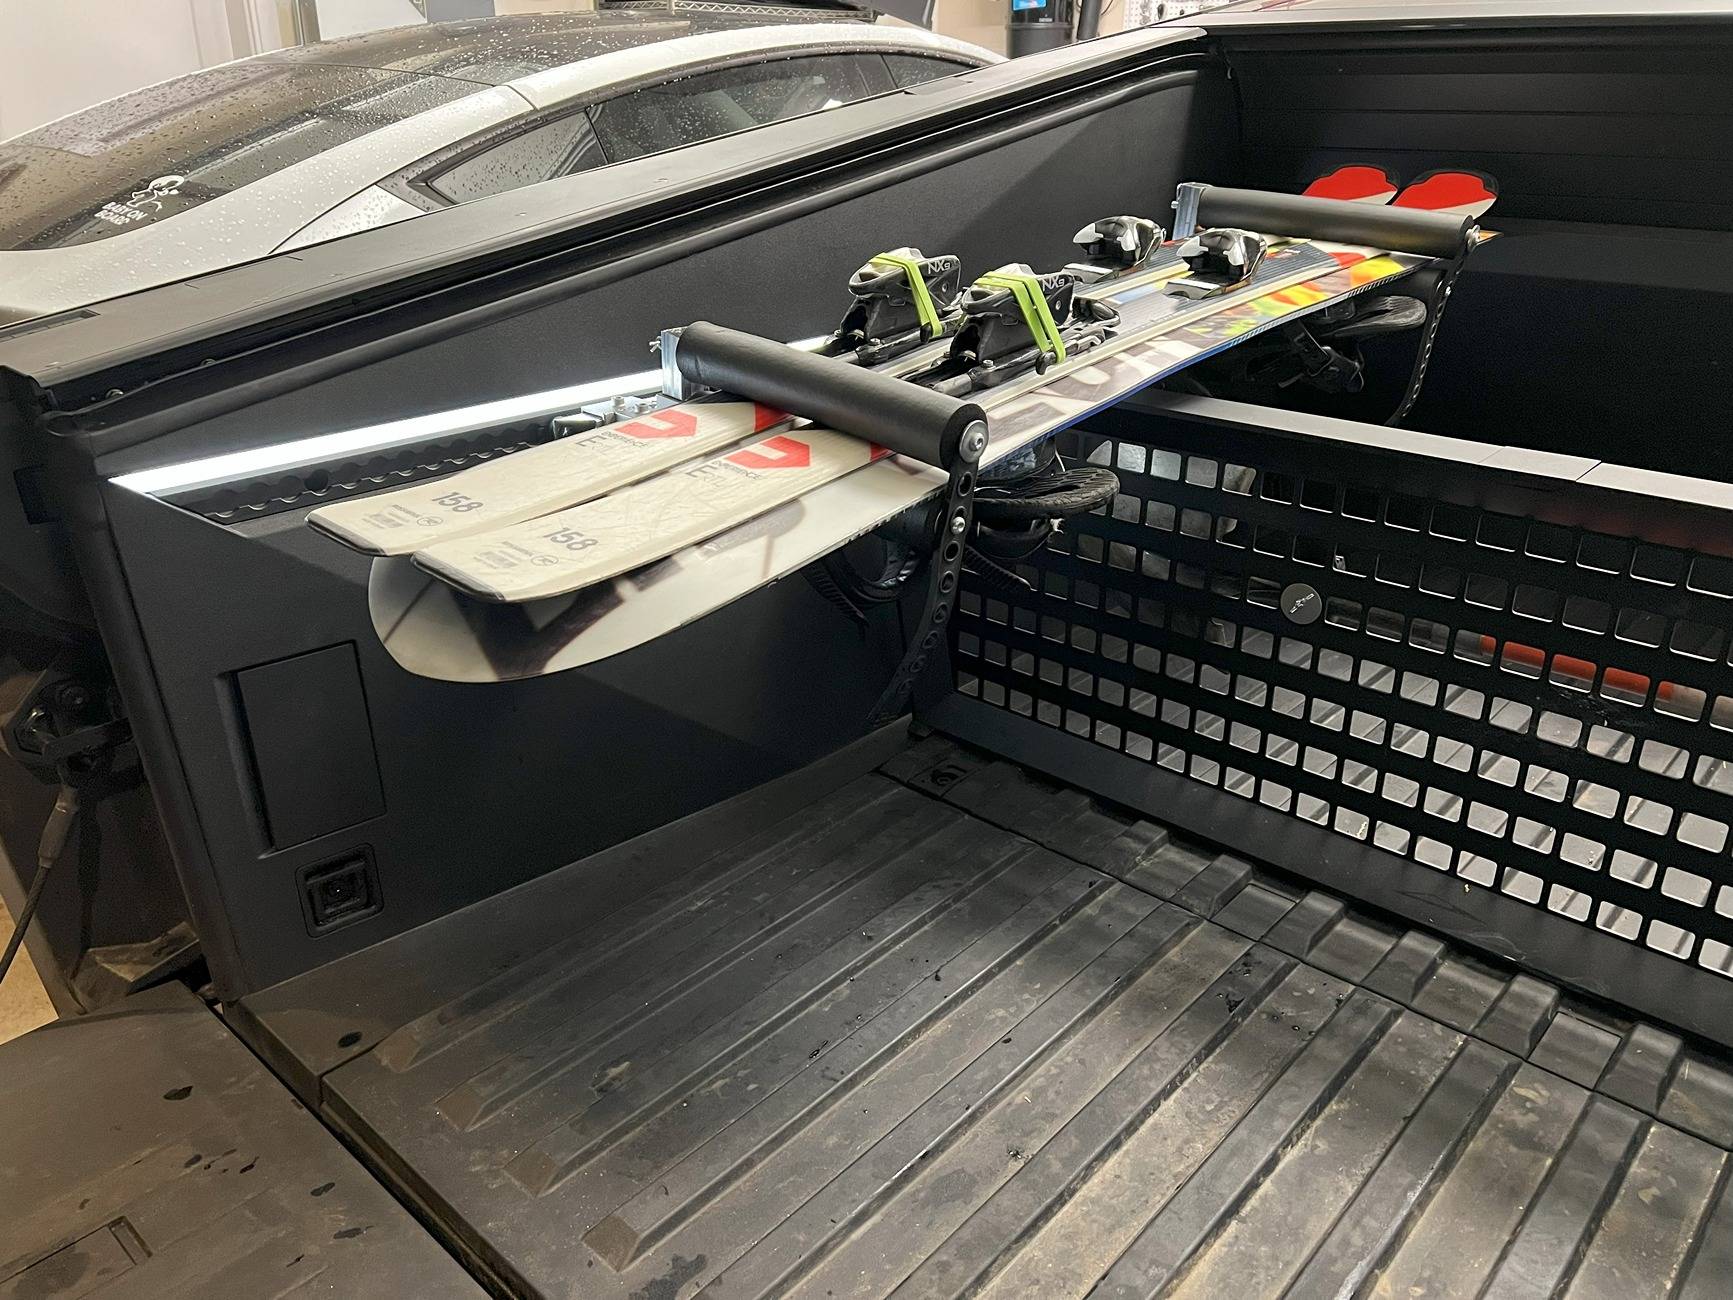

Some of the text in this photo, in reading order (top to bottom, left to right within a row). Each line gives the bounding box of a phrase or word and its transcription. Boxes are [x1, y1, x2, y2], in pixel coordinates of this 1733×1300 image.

[94, 209, 131, 225] BOARD
[102, 202, 148, 220] BABY ON
[926, 259, 951, 275] NX9
[1041, 274, 1065, 292] NX9
[431, 491, 484, 513] 158
[542, 526, 599, 551] 158
